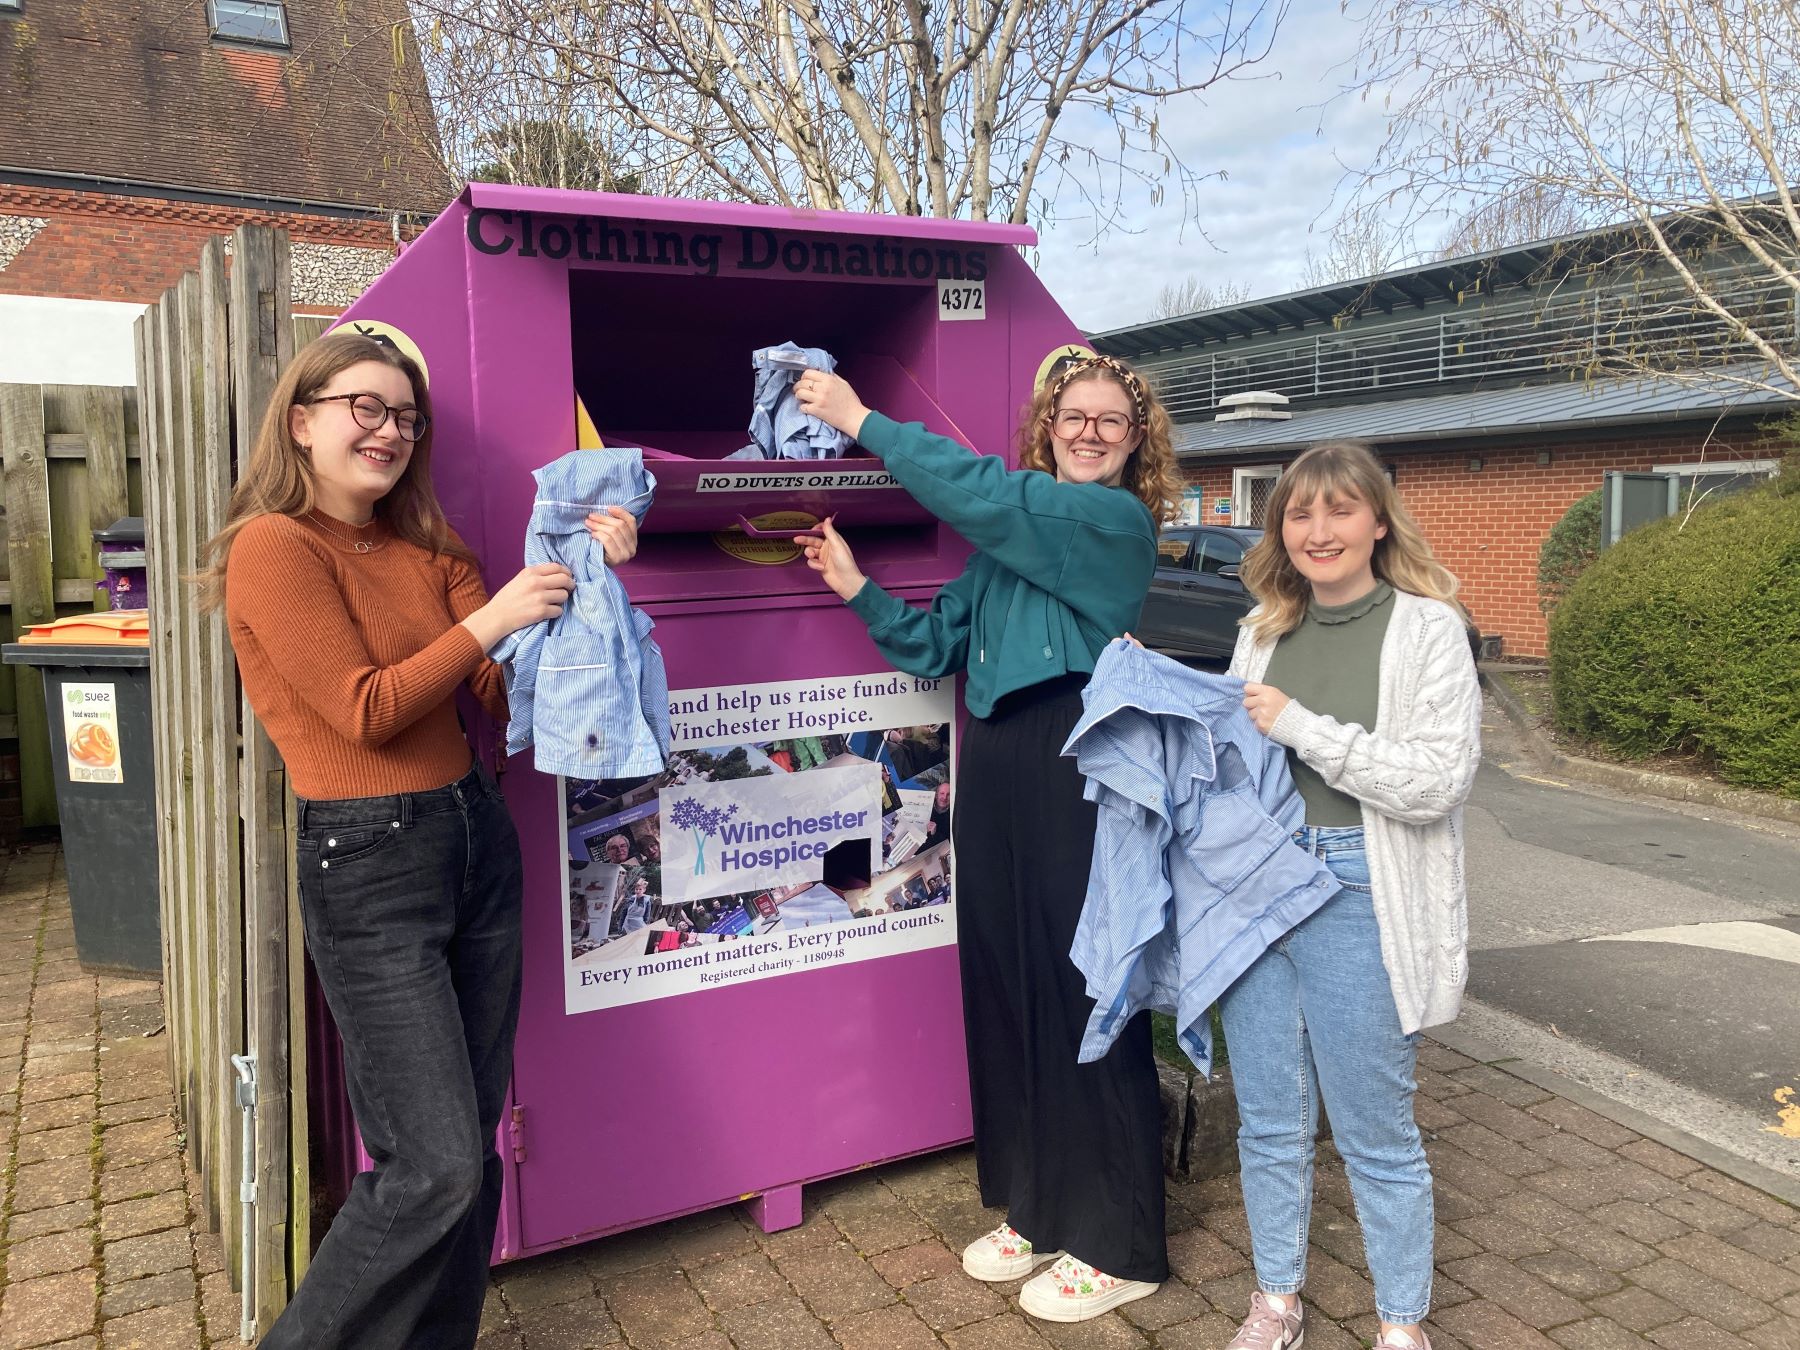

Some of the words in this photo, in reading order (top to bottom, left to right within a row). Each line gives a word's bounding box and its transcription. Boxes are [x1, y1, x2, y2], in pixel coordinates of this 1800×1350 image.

[467, 207, 722, 276] Clothing
[737, 227, 987, 281] Donations
[941, 288, 982, 310] 4372
[700, 477, 730, 489] NO
[734, 476, 804, 488] DUVETS
[808, 475, 834, 487] OR
[84, 692, 110, 702] suez
[669, 693, 709, 715] and
[717, 690, 762, 713] help
[770, 691, 791, 706] us
[799, 684, 847, 703] raise
[853, 677, 907, 698] funds
[914, 677, 941, 692] for
[72, 710, 83, 718] food
[787, 707, 873, 730] Hospice.
[719, 810, 868, 846] Winchester
[721, 841, 828, 872] Hospice
[580, 967, 632, 987] Every
[637, 952, 711, 977] moment
[715, 940, 782, 958] matters.
[788, 931, 832, 949] Every
[837, 919, 887, 945] pound
[891, 912, 944, 931] counts.
[700, 964, 755, 984] Registered
[758, 957, 794, 972] charity
[804, 948, 845, 964] 1180948
